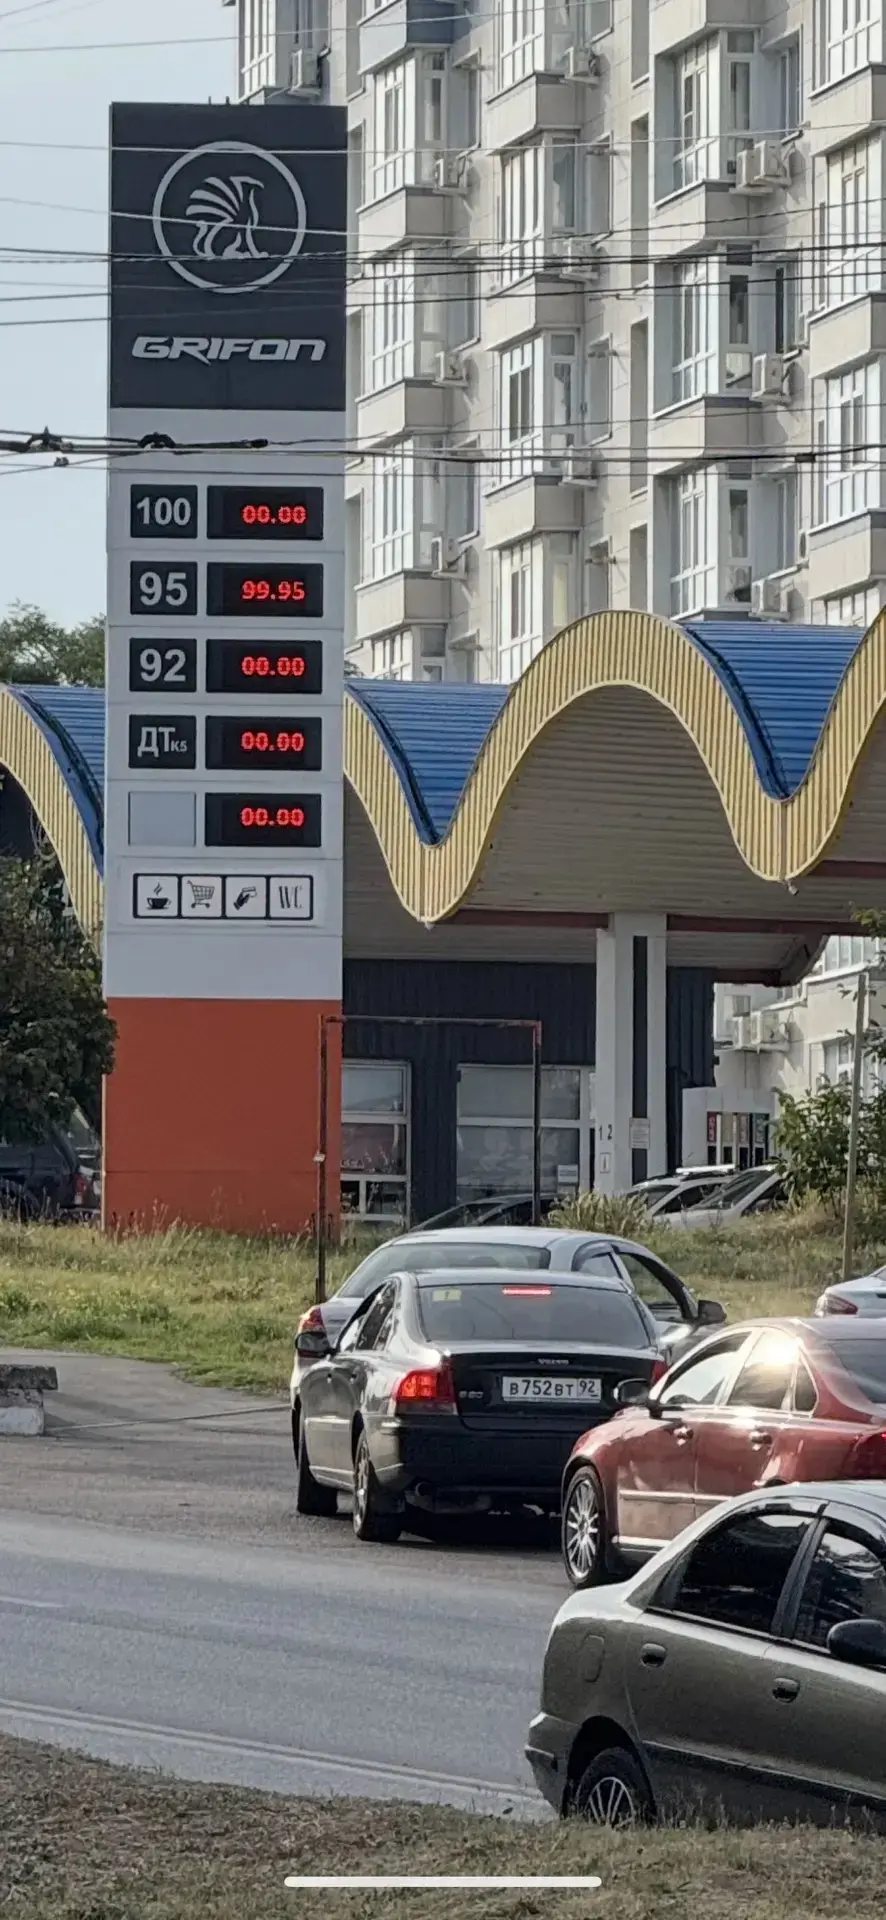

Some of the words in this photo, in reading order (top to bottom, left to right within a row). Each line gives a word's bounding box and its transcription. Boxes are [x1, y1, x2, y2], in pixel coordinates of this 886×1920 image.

[131, 336, 326, 366] GRIFON
[137, 497, 191, 526] 100
[242, 505, 307, 524] 00.00
[139, 571, 188, 606] 95
[242, 581, 305, 600] 99.95
[139, 649, 186, 682] 92
[241, 656, 305, 676] 00.00
[241, 732, 304, 752] 00.00
[241, 808, 304, 826] 00.00
[279, 885, 304, 909] WC
